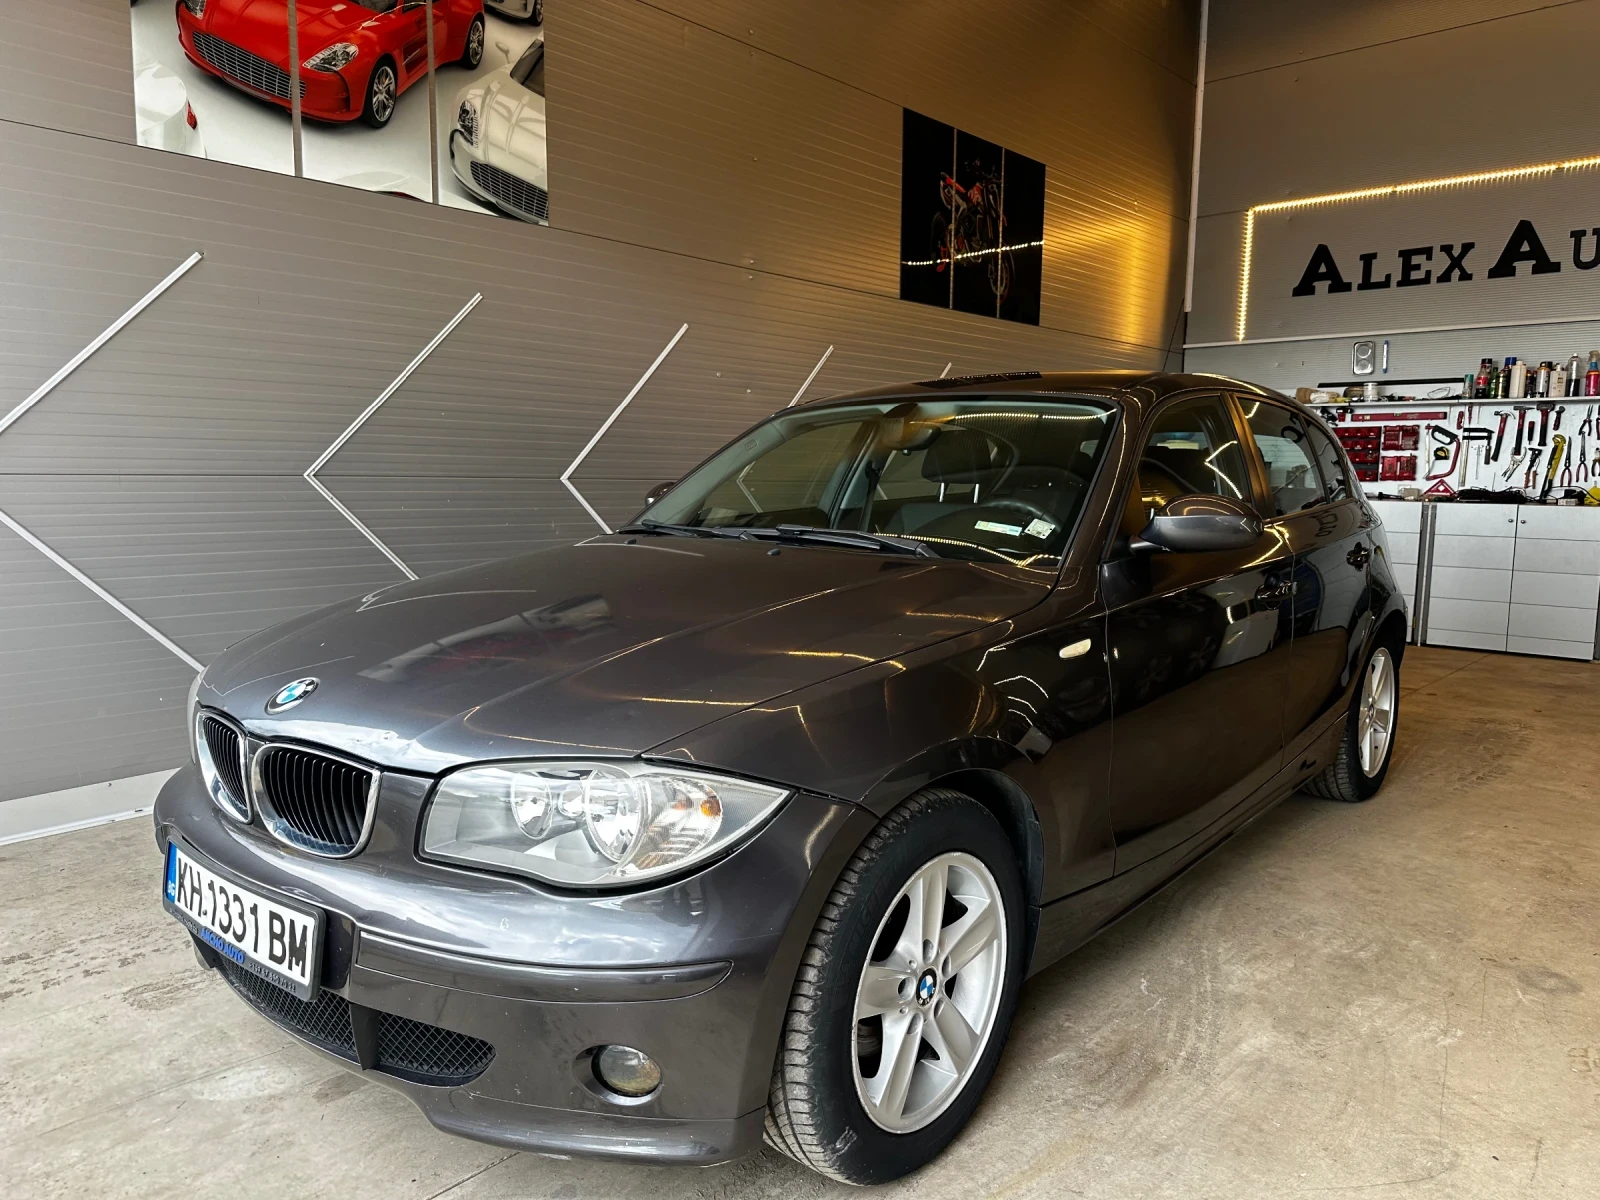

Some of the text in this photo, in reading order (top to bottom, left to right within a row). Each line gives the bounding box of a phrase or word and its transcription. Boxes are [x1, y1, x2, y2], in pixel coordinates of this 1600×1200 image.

[1292, 242, 1475, 297] ALEX
[223, 943, 245, 964] AUTO
[269, 910, 308, 978] BM
